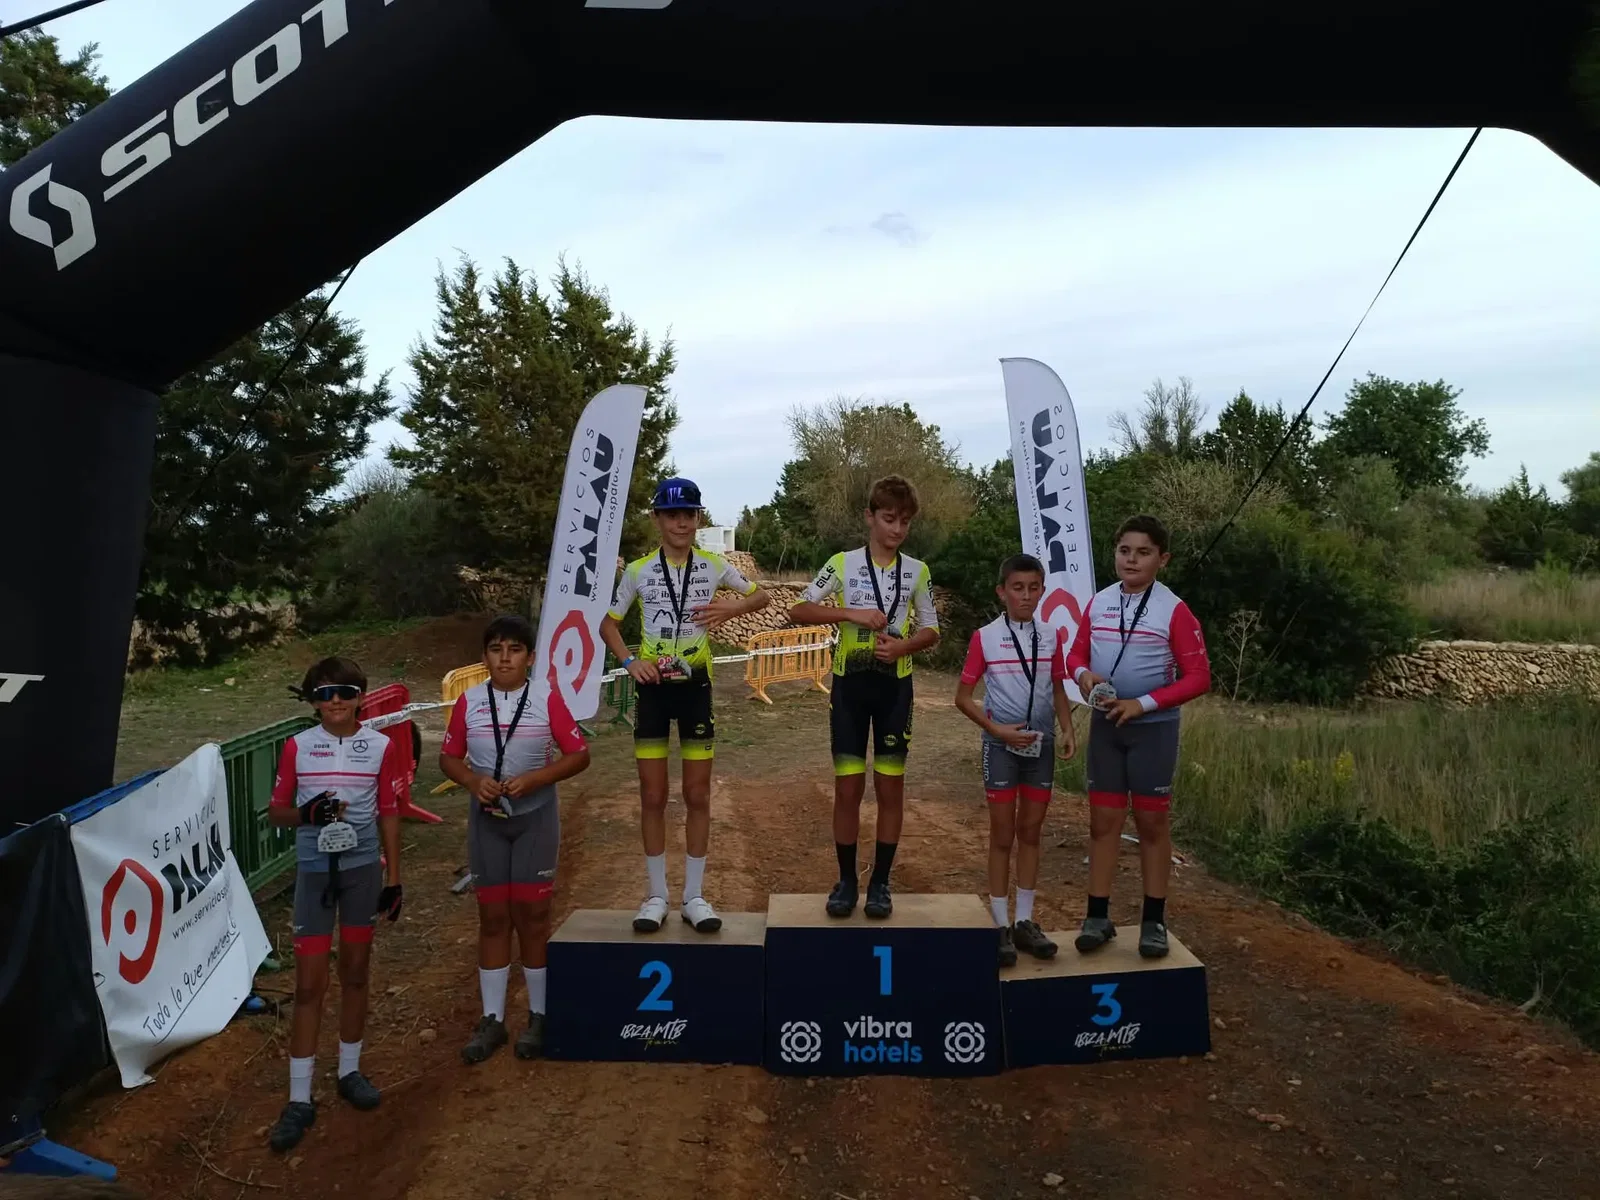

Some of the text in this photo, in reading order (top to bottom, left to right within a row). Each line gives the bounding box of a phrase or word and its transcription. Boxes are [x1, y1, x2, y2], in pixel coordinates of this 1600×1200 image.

[101, 0, 394, 202] SCOT
[560, 427, 595, 595] SERVICIOS
[574, 433, 615, 598] PALAU
[636, 960, 674, 1011] 2
[873, 945, 892, 996] 1
[143, 1001, 171, 1038] Todo
[170, 986, 182, 1010] lo
[183, 963, 203, 995] que
[1090, 982, 1122, 1026] 3
[652, 1018, 688, 1040] MTB
[843, 1015, 912, 1039] vibra
[843, 1040, 923, 1064] hotels
[1106, 1022, 1141, 1044] MTB
